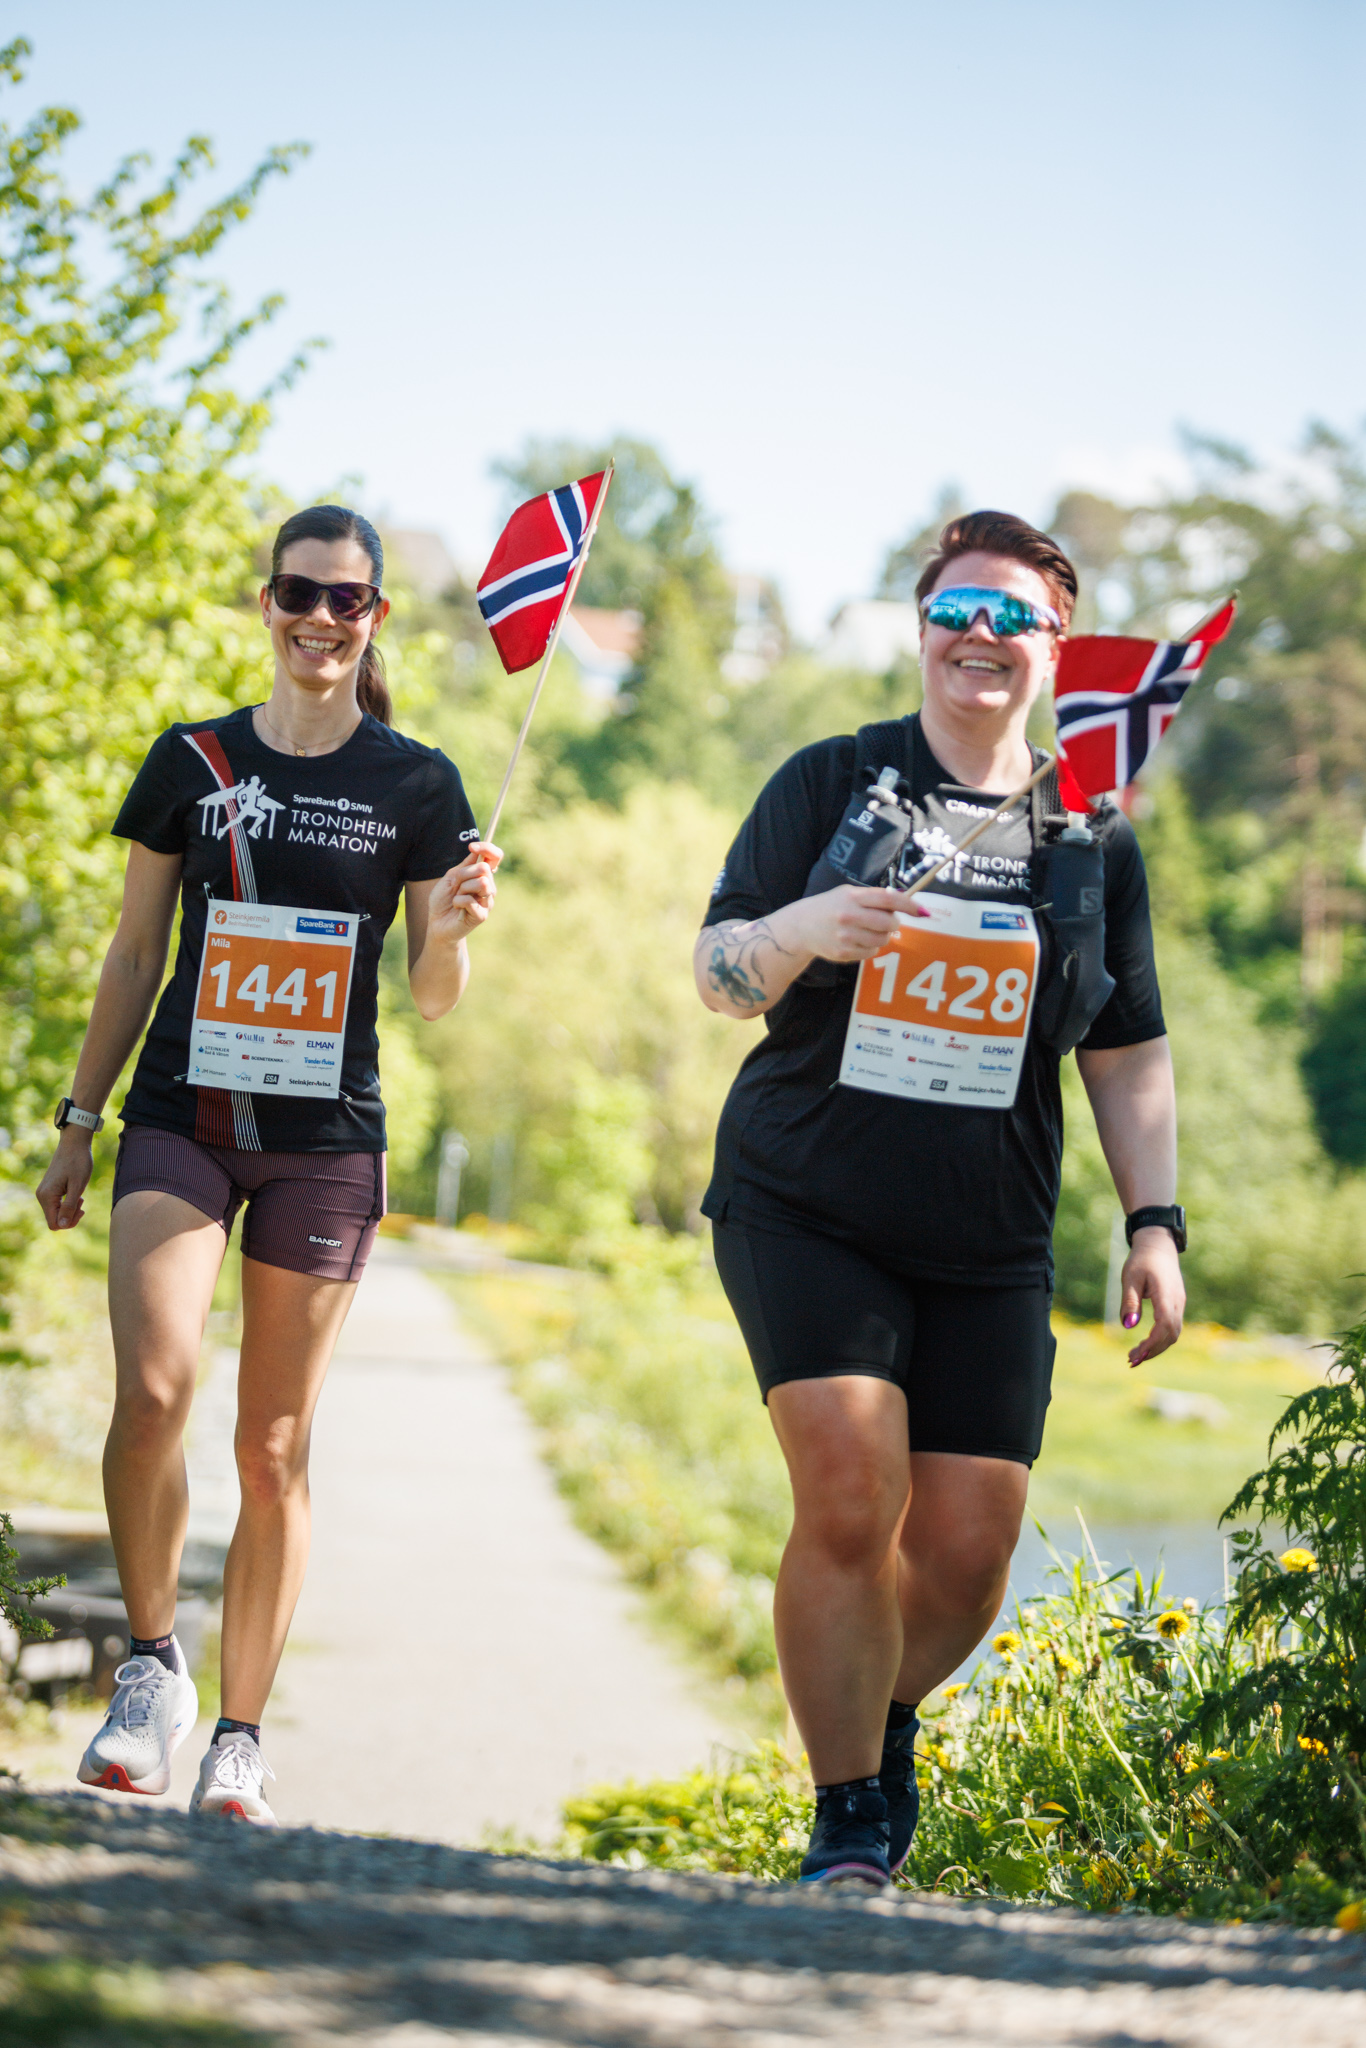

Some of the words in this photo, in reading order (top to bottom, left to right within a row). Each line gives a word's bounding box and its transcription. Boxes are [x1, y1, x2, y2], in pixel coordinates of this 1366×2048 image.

[293, 794, 337, 807] SpareBank
[351, 803, 373, 814] SMN
[946, 799, 997, 820] CRAFT
[291, 809, 397, 840] TRONDHEIM
[287, 827, 378, 855] MARATON
[972, 855, 1031, 876] TROND
[229, 911, 270, 923] Steinkjermila
[299, 919, 336, 929] SpareBank
[211, 937, 231, 949] Mila
[210, 959, 338, 1019] 1441
[873, 951, 1029, 1023] 1428
[306, 1040, 335, 1049] ELMAN
[982, 1045, 1014, 1055] ELMAN
[265, 1075, 278, 1084] SSA
[308, 1235, 343, 1248] BANDIT
